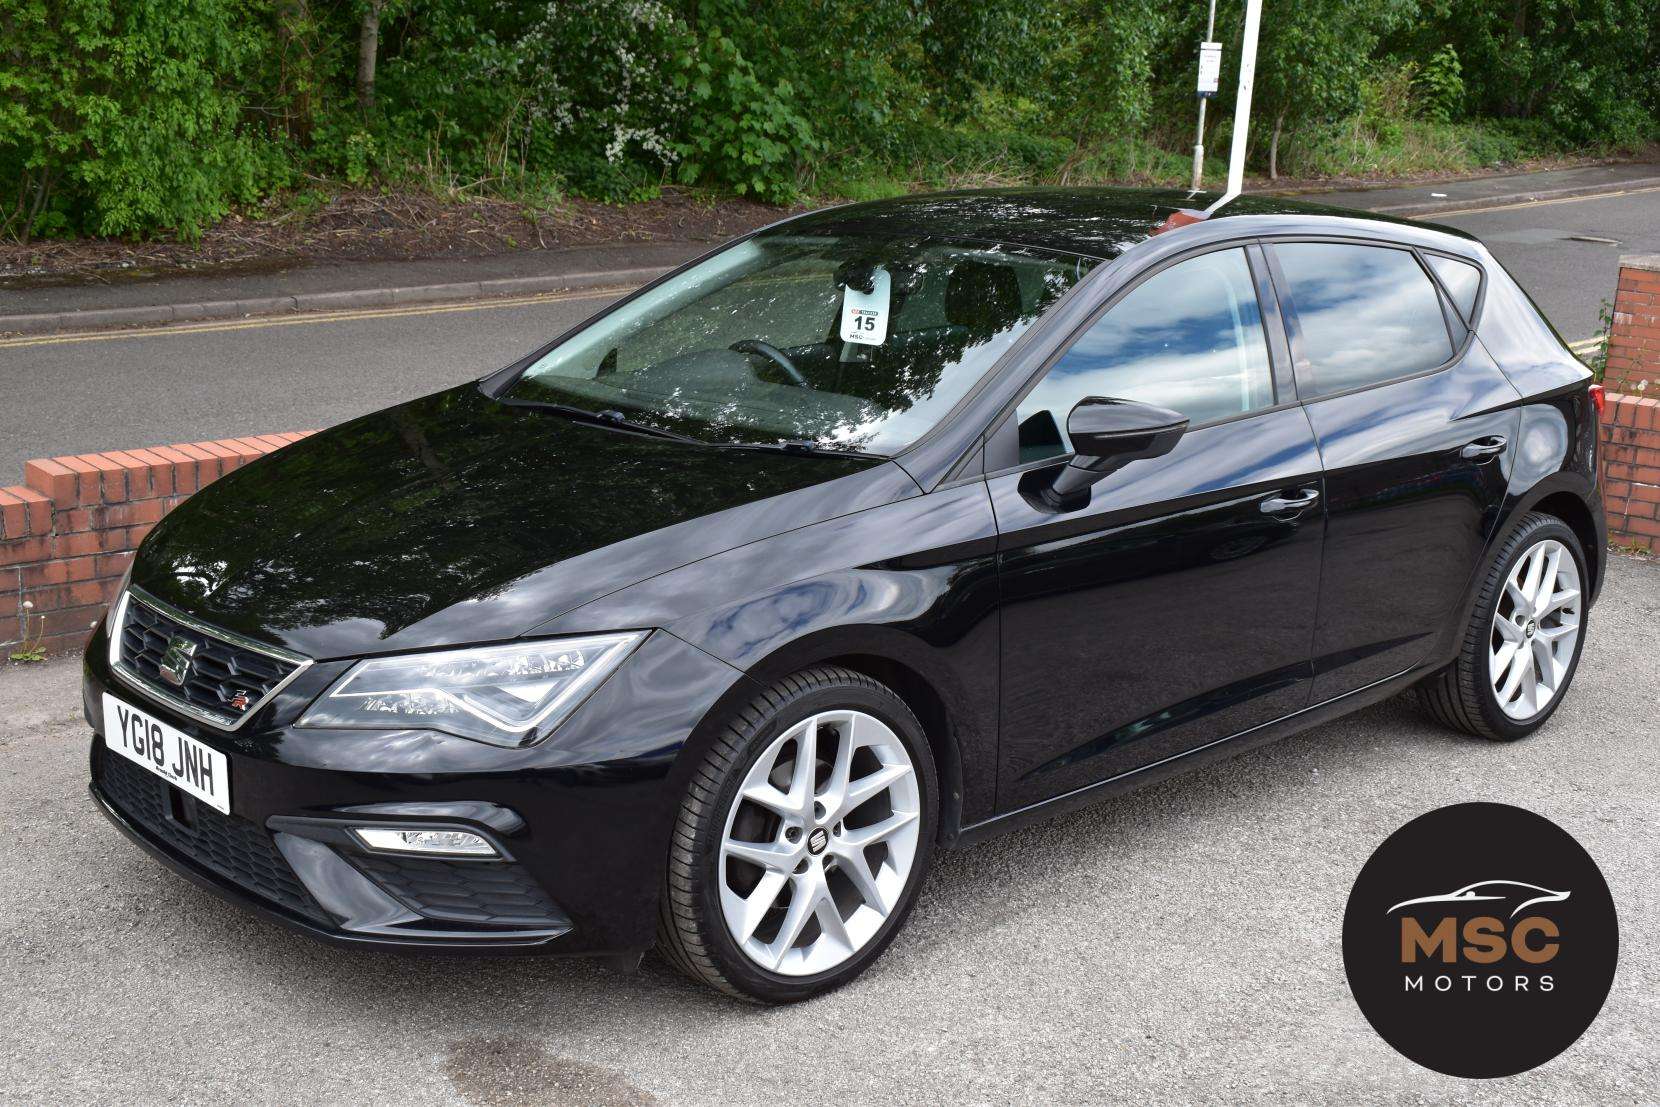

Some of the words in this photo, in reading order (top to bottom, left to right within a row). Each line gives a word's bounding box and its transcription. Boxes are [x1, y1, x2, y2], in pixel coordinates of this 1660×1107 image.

[854, 315, 876, 331] 15
[116, 704, 165, 767] YG18
[171, 736, 214, 796] JNH
